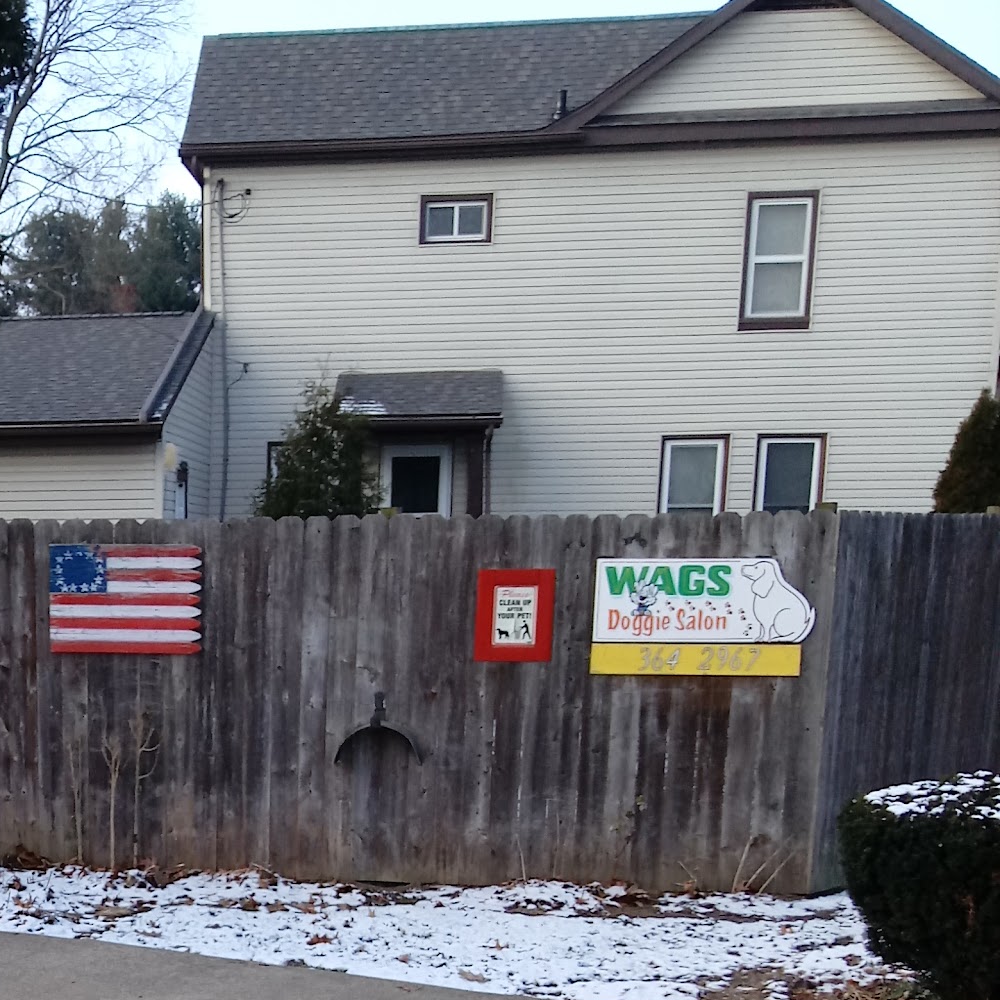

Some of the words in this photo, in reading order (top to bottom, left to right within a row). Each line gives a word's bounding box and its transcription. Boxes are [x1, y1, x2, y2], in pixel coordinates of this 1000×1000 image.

[605, 564, 733, 597] WAGS
[608, 609, 671, 636] Doggie
[676, 608, 727, 631] Salon
[638, 646, 681, 672] 364
[697, 646, 761, 672] 2967
